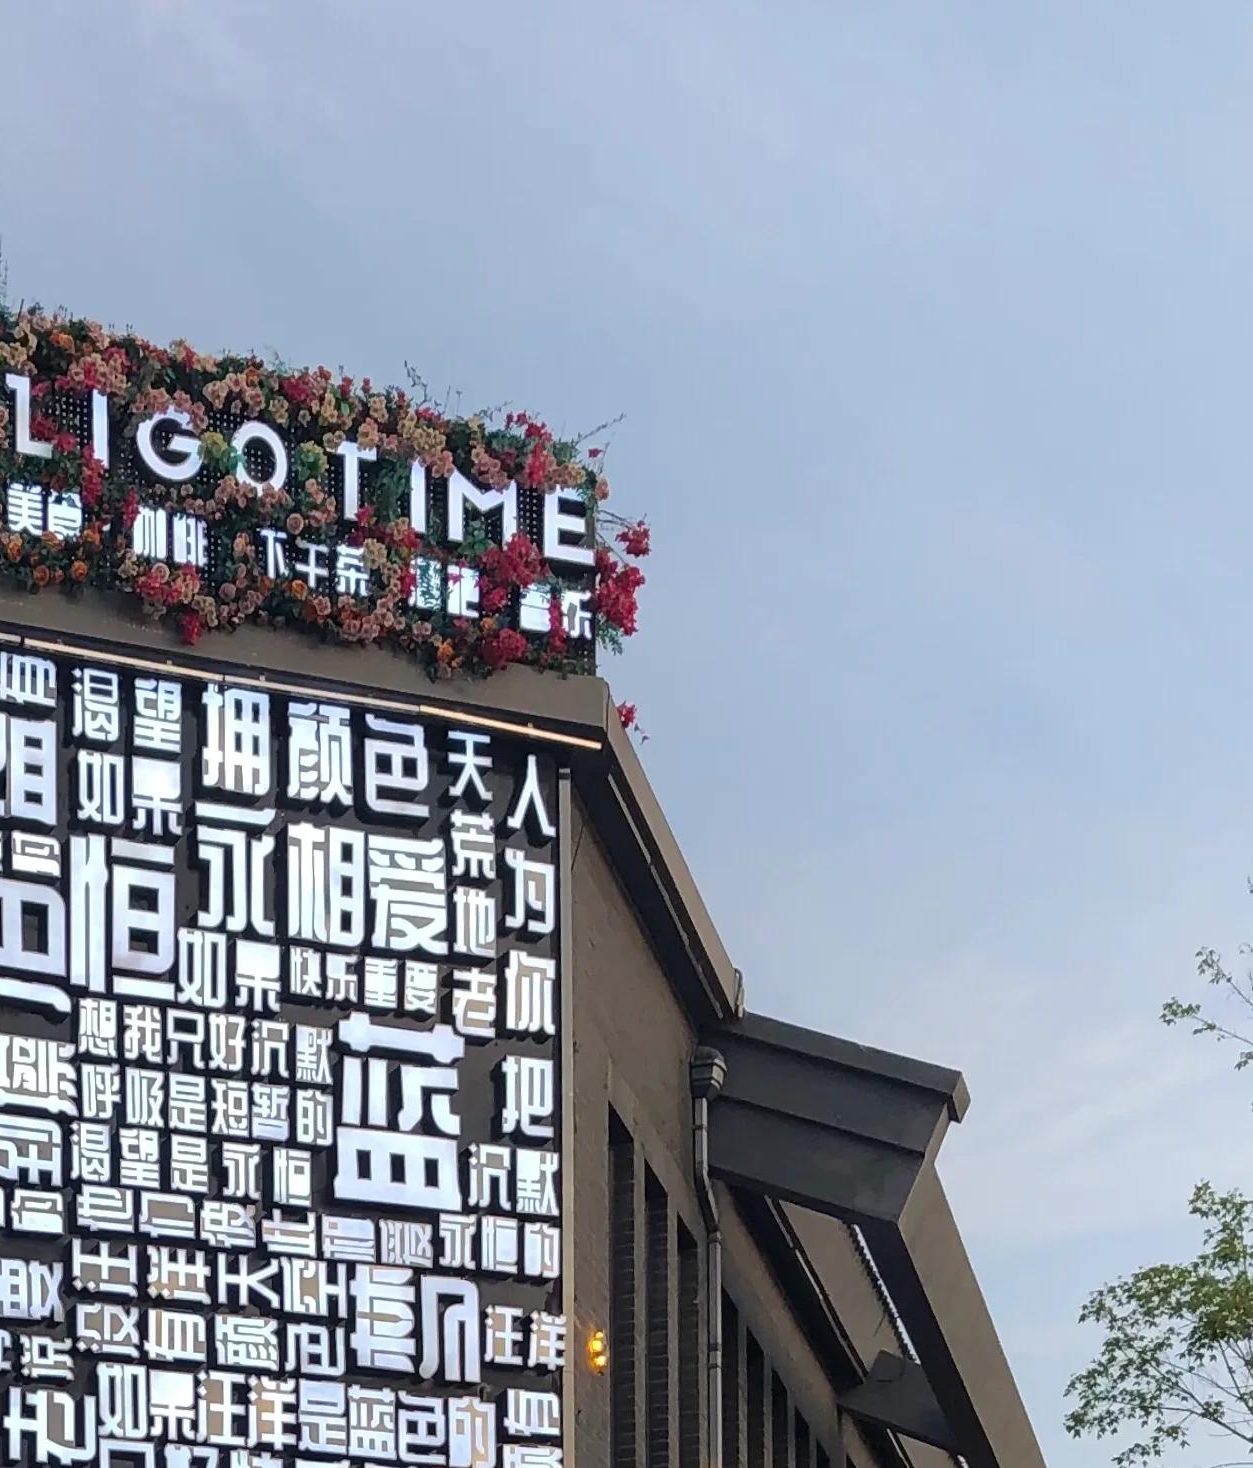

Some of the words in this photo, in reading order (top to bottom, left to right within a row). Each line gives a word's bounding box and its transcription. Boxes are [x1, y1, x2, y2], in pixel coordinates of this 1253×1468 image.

[5, 372, 290, 494] LIGO
[335, 440, 596, 566] TIME
[79, 998, 333, 1084] 想我只好沉默
[82, 1064, 333, 1145] 呼吸是短暂的
